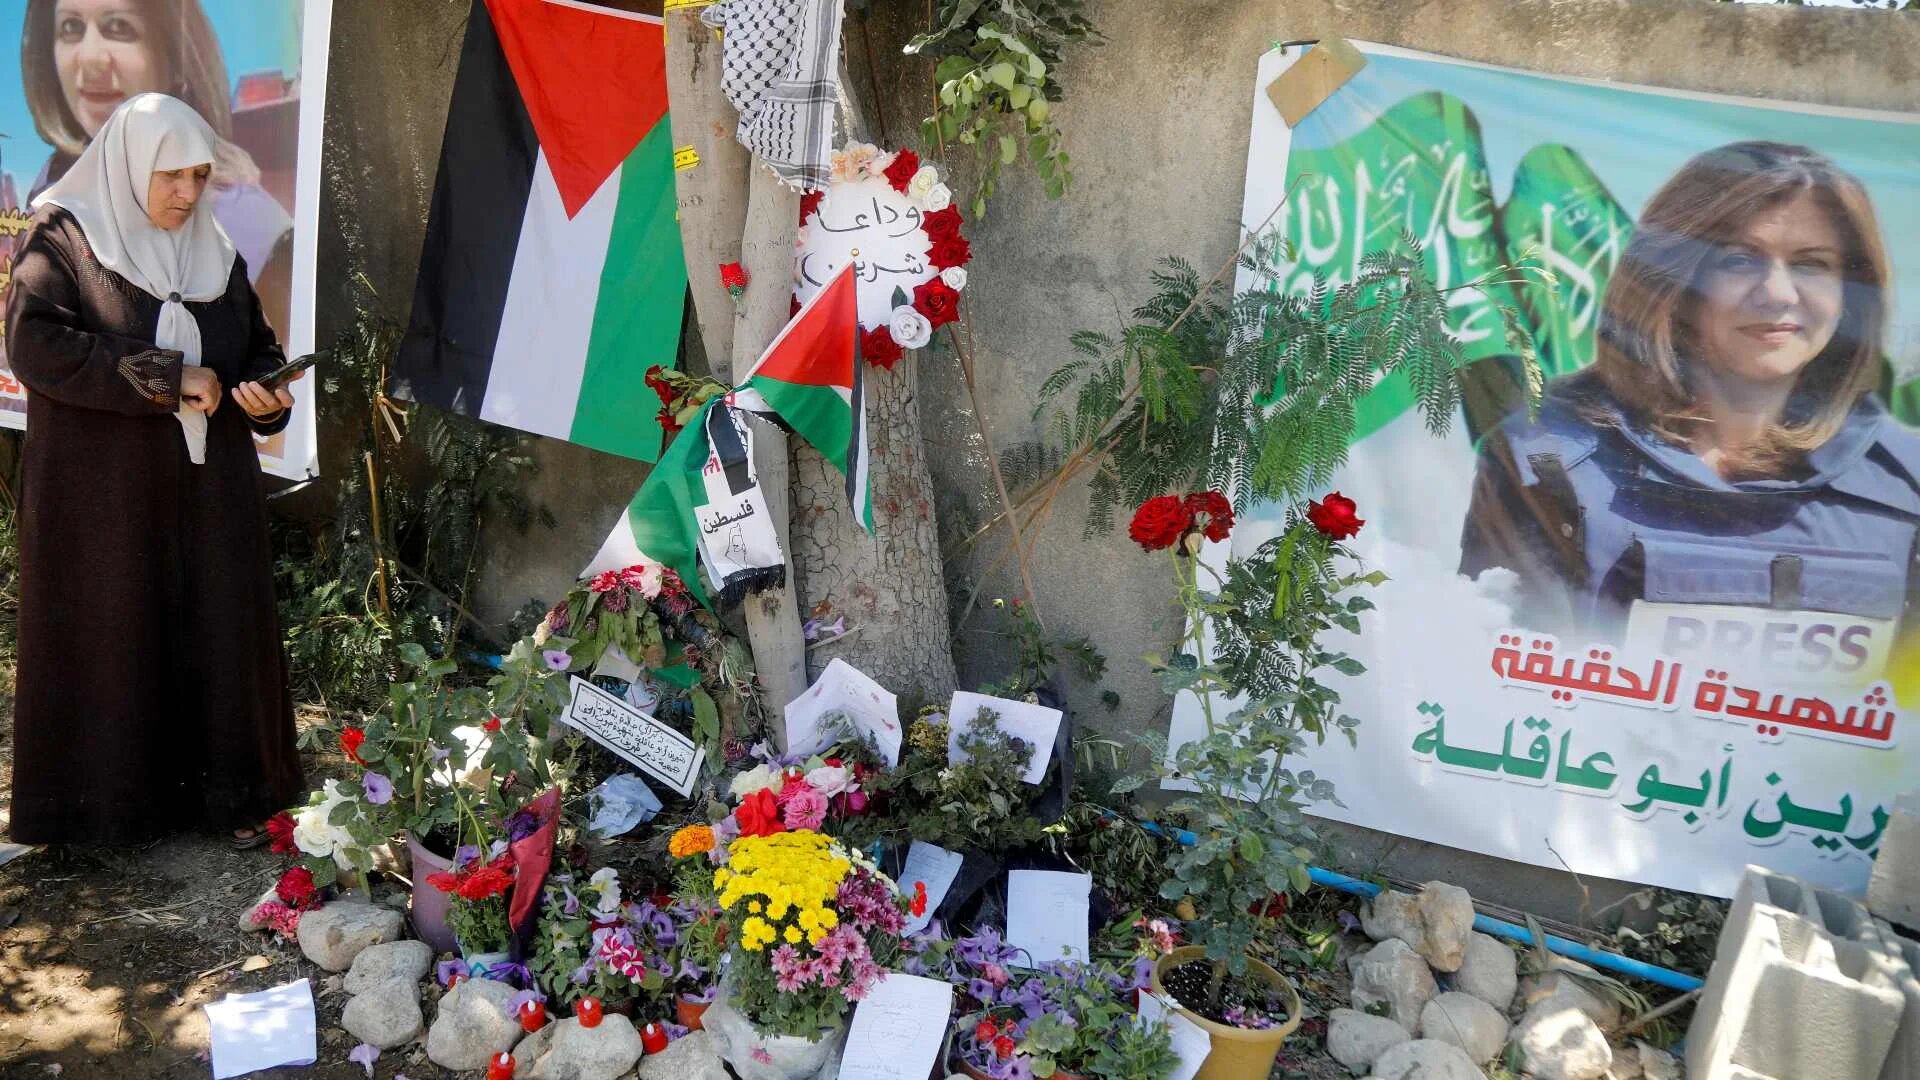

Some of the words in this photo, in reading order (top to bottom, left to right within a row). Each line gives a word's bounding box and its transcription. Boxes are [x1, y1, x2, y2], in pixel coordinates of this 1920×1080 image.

[815, 196, 921, 238] وداعا
[703, 499, 755, 534] فلسطين
[1490, 633, 1684, 704] الحقيقة
[1663, 615, 1873, 673] PRESS
[1693, 668, 1898, 743] شهيدة
[1410, 699, 1618, 791] عاقلة
[1620, 743, 1733, 827] أبو
[1742, 771, 1891, 861] رين
